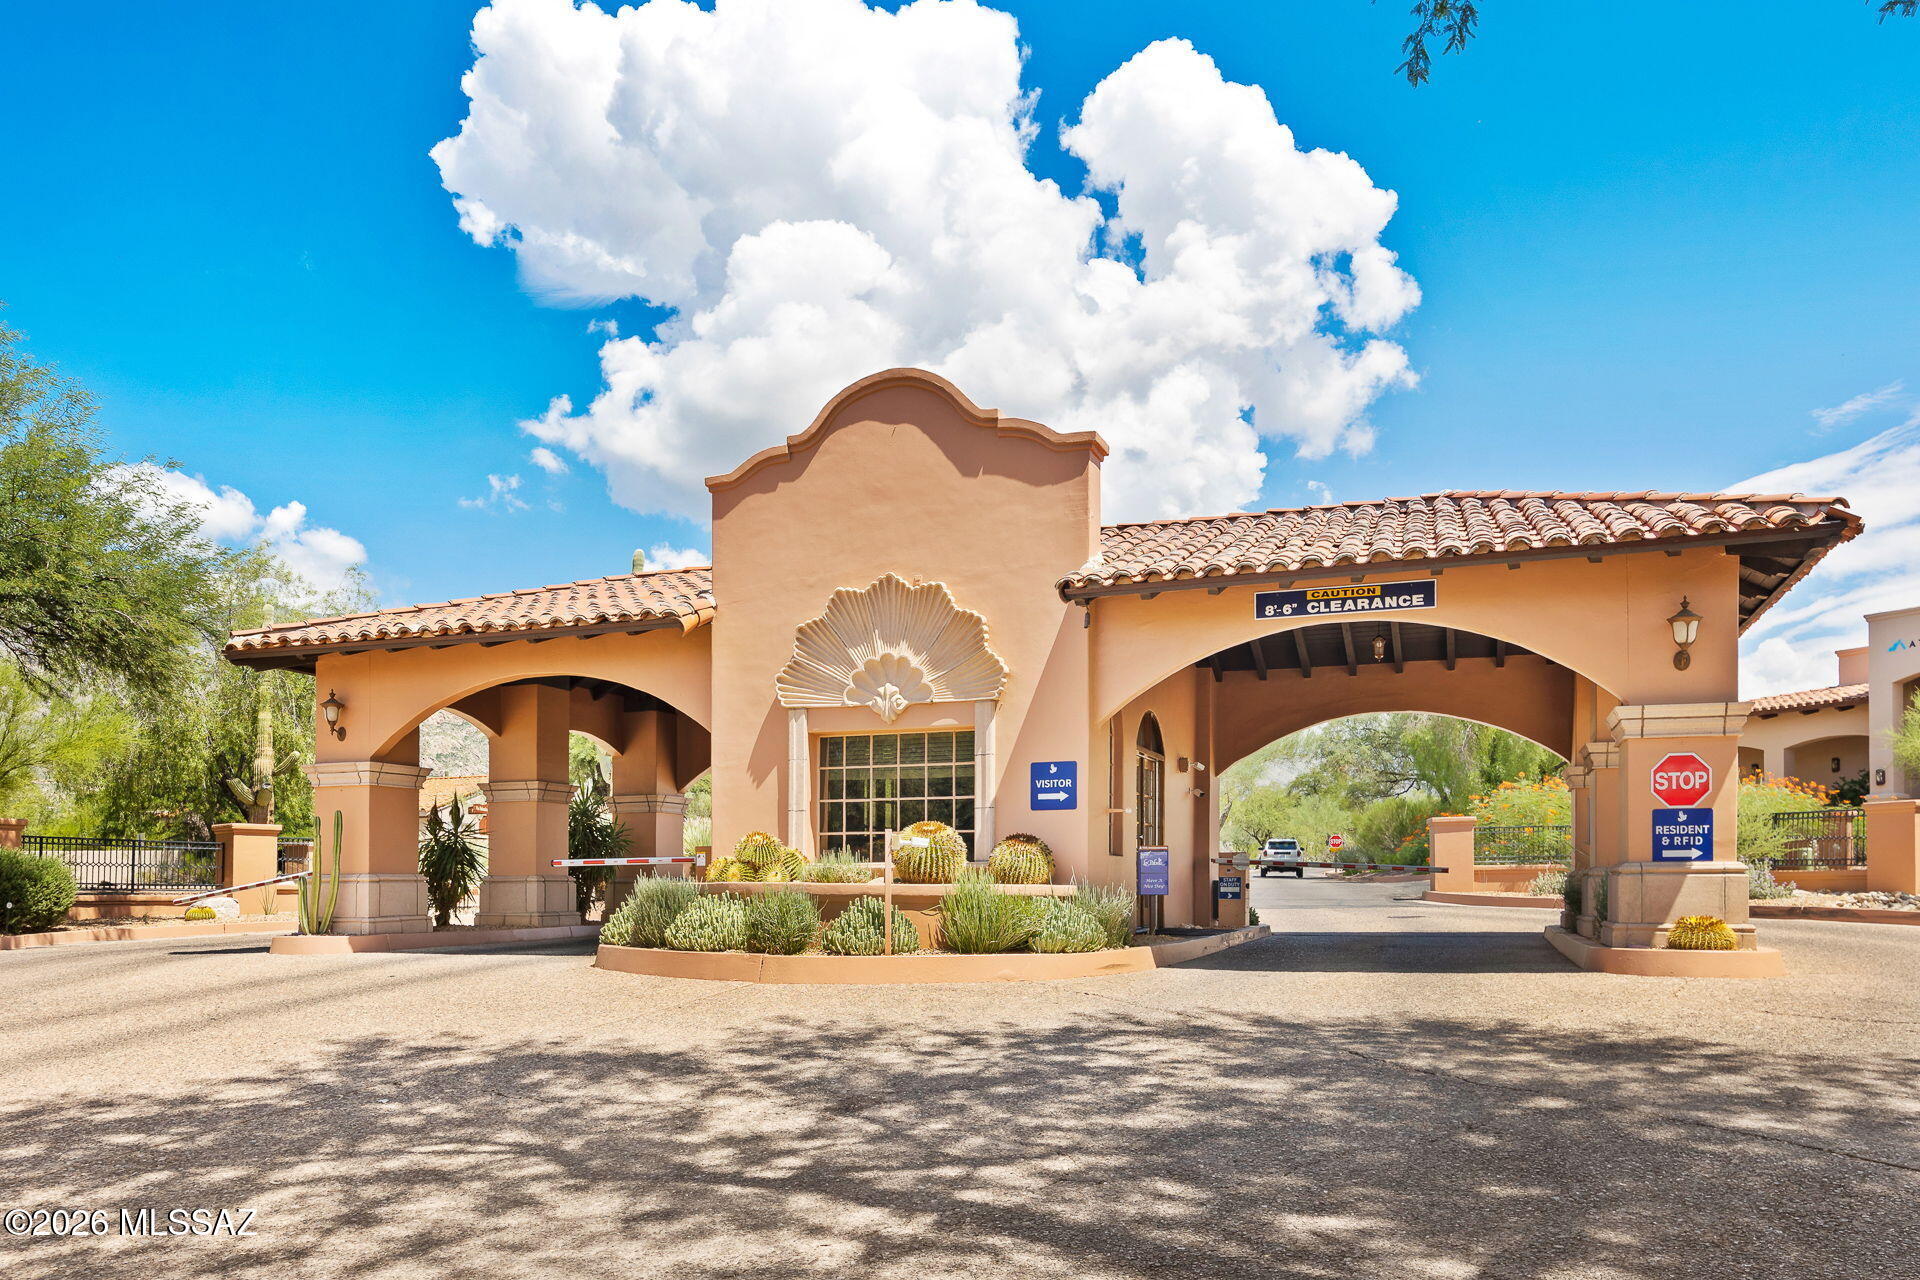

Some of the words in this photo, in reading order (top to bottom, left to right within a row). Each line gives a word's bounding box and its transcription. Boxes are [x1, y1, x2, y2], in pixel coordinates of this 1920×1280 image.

[1311, 588, 1376, 598] CAUTION
[1306, 594, 1424, 614] CLEARANCE
[1909, 639, 1920, 648] A
[1035, 779, 1072, 788] VISITOR
[1655, 771, 1707, 790] STOP
[1656, 825, 1710, 834] RESIDENT
[1662, 837, 1670, 845] &
[1674, 837, 1703, 845] RFID
